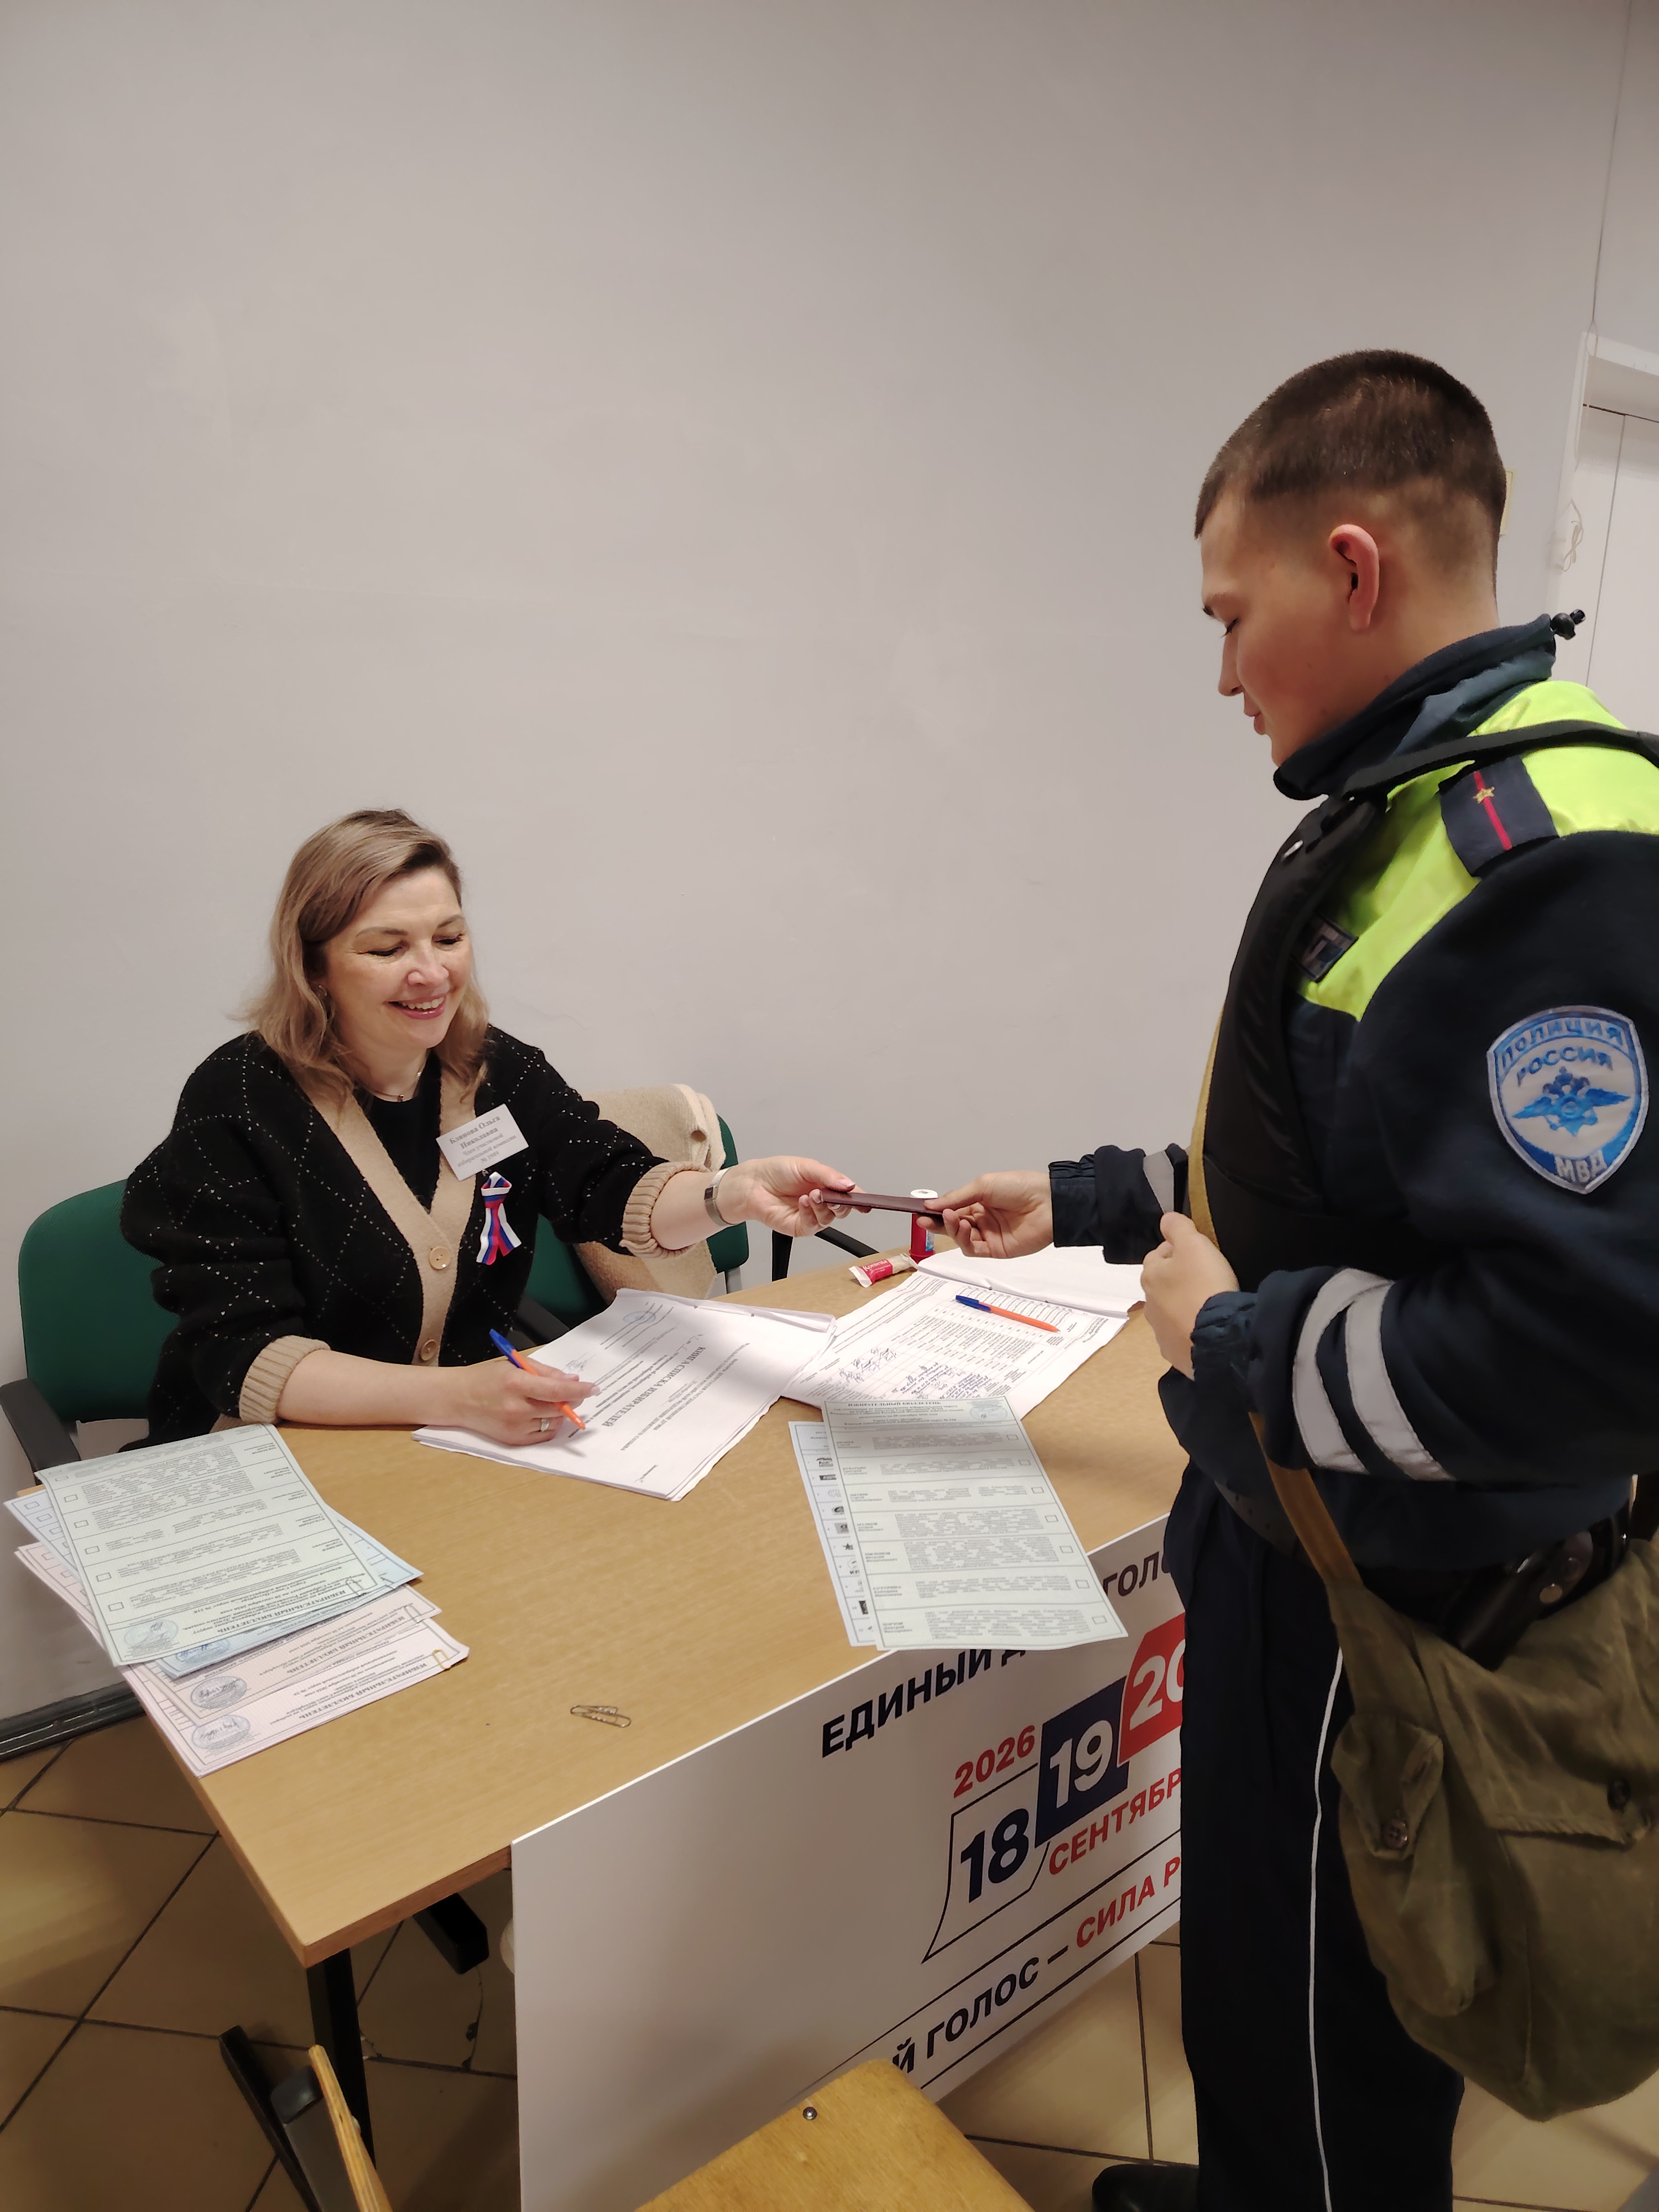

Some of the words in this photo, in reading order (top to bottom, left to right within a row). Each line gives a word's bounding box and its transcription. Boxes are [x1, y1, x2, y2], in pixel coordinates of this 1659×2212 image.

[1502, 1019, 1624, 1066] ПОЛИЦИЯ
[1517, 1046, 1613, 1087] РОССИЯ
[478, 1116, 500, 1129] Ольга
[1554, 1149, 1608, 1183] МВД
[653, 1363, 686, 1389] СПИСКА
[601, 1386, 658, 1427] ИЗБИРАТЕЛЕЙ
[1103, 1551, 1171, 1597] ГОЛ
[273, 1589, 347, 1616] ИЗБИРАТЕЛЬНЫЙ
[216, 1613, 273, 1634] БЮЛЛЕТЕНЬ
[953, 1725, 1035, 1799] 2026
[960, 1808, 1029, 1903] 18
[1050, 1720, 1113, 1809] 19
[927, 1957, 1039, 2059] ГОЛОС
[1076, 1875, 1155, 1948] СИЛА
